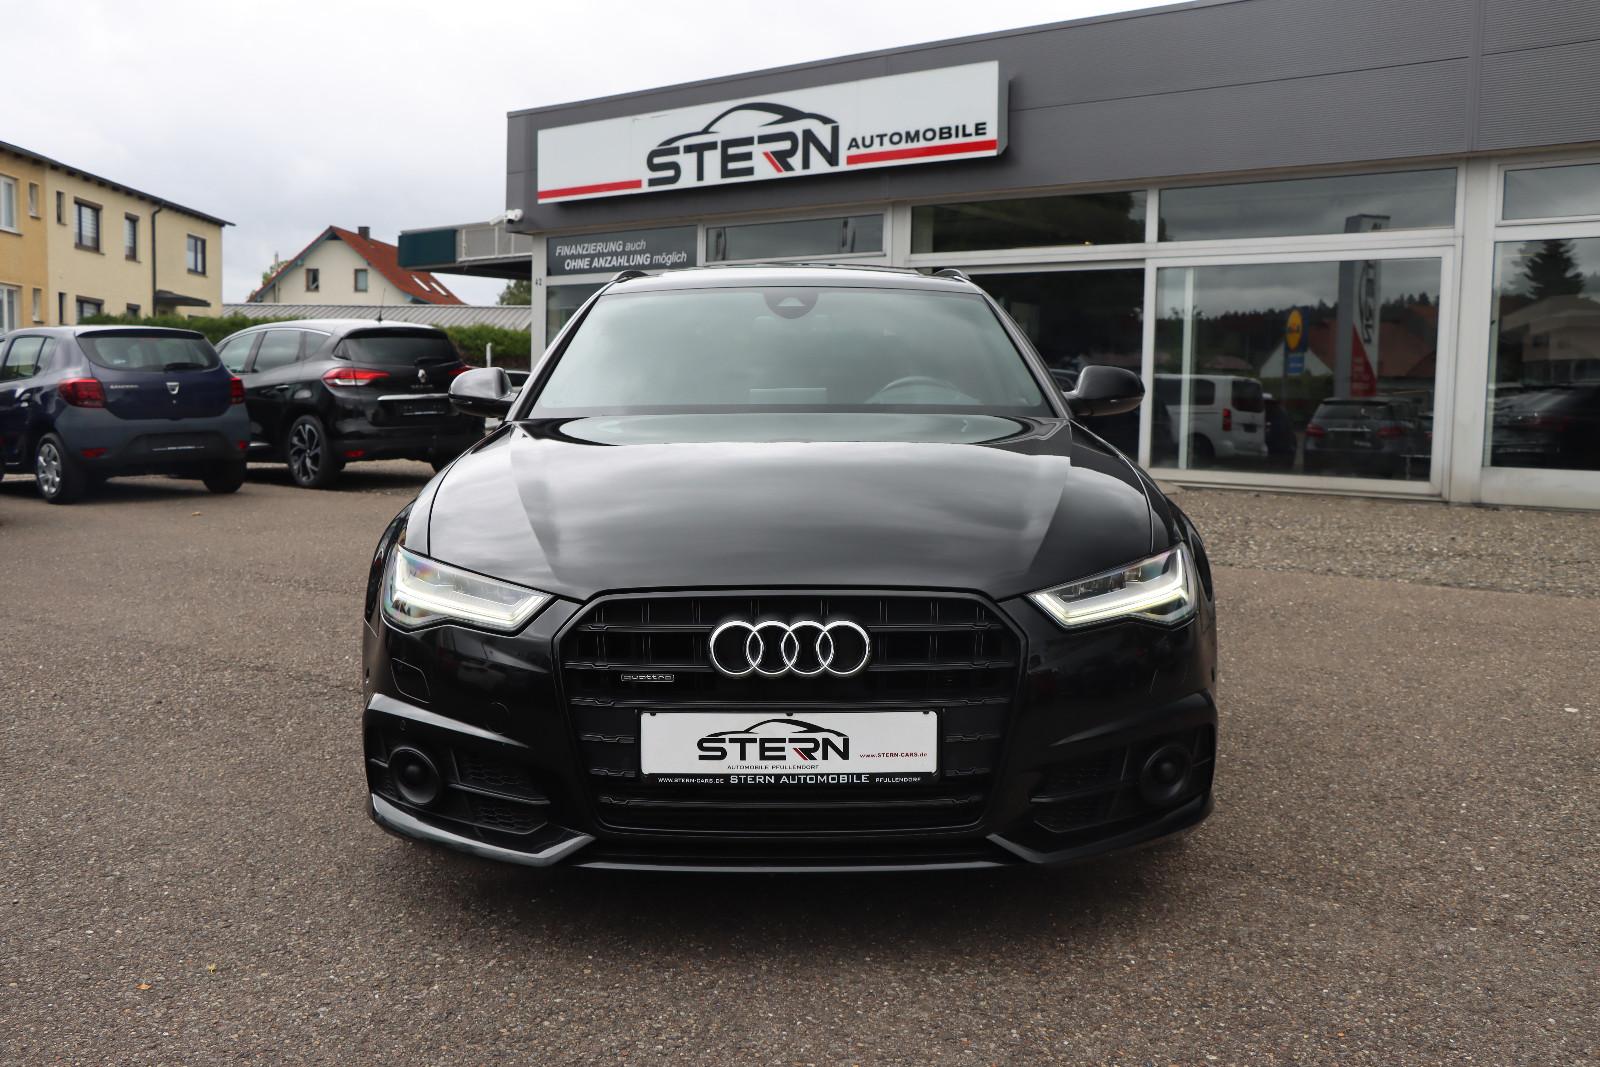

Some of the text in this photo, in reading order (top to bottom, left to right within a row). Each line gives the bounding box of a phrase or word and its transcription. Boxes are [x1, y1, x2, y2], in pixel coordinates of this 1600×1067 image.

[647, 122, 987, 187] STERN AUTOMOBILE
[556, 239, 646, 256] FINANZIERUNG auch
[564, 251, 687, 270] OHNE ANZAHLUNG möglich
[697, 737, 849, 761] STERN
[730, 775, 775, 784] STERN
[780, 774, 870, 784] AUTOMOBILE
